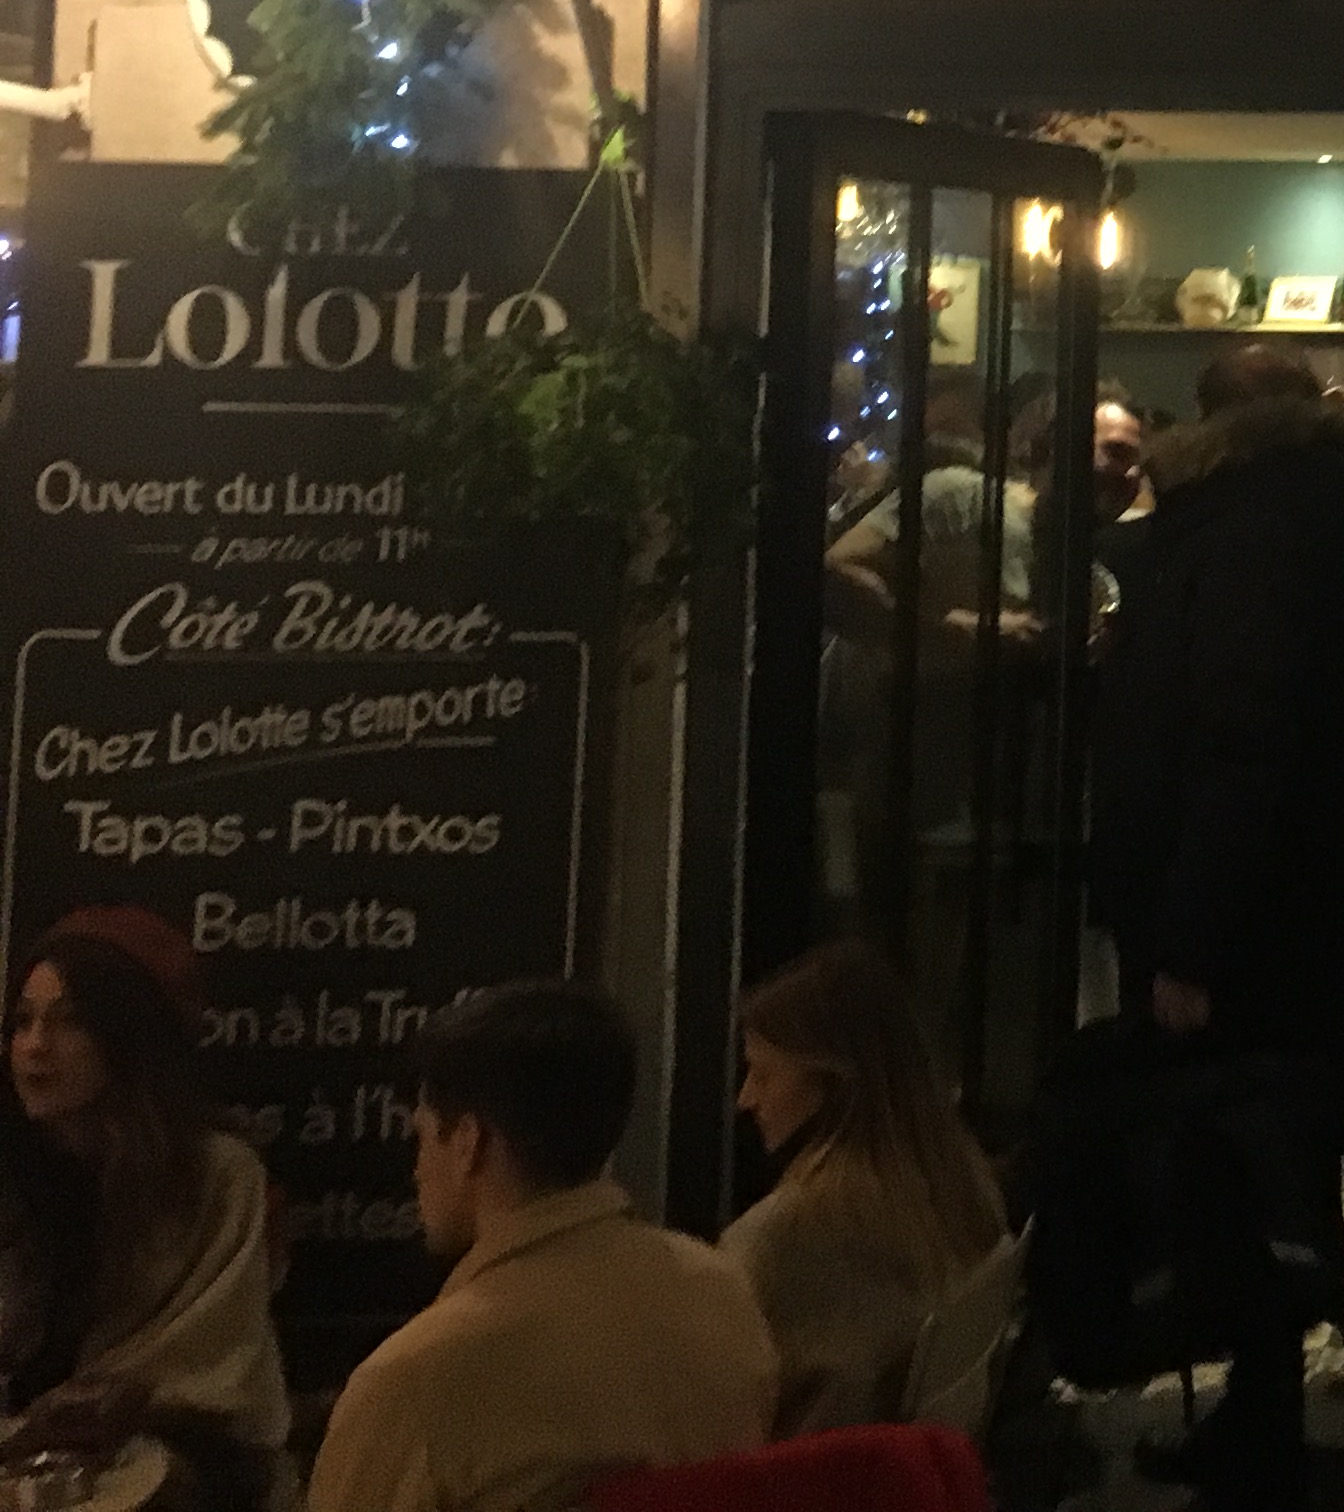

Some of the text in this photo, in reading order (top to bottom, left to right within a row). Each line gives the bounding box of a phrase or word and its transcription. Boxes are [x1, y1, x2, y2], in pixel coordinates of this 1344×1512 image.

[36, 459, 203, 515] Ouvert
[216, 472, 275, 514] du
[106, 581, 270, 667] Côté
[34, 724, 158, 782] Chez
[167, 705, 312, 766] Lolotte
[63, 799, 245, 864] Tapas
[288, 797, 501, 855] Pintxos
[191, 890, 419, 955] Bellotta
[314, 986, 364, 1047] la
